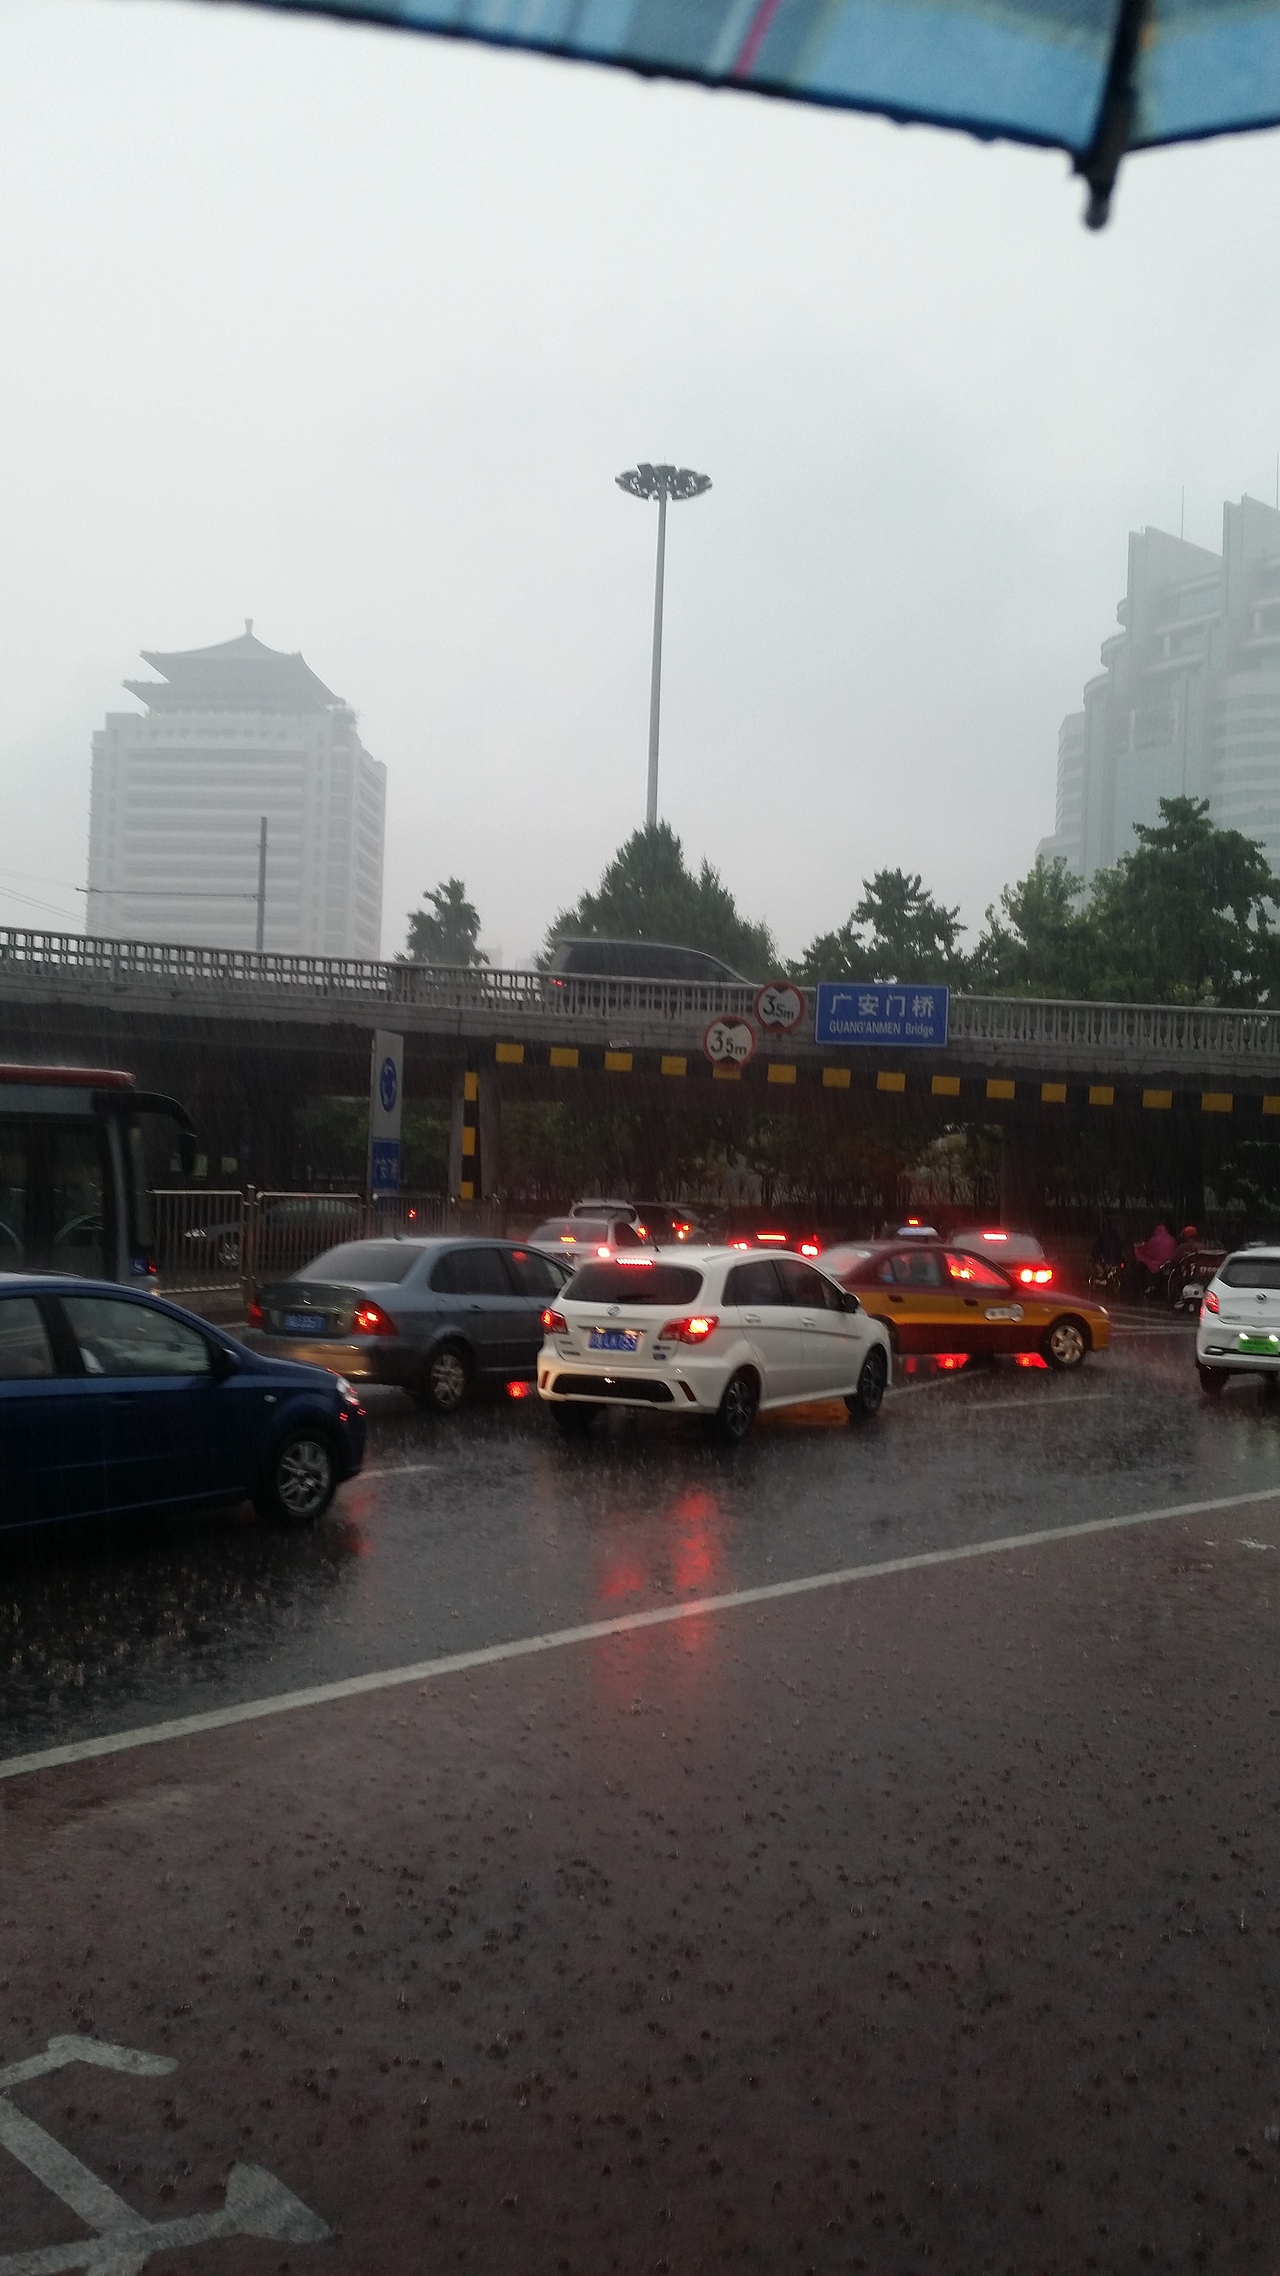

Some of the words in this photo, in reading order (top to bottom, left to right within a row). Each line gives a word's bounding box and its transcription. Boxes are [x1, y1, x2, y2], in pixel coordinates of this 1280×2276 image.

[830, 993, 935, 1018] 广安门桥
[905, 1022, 935, 1039] Bridge
